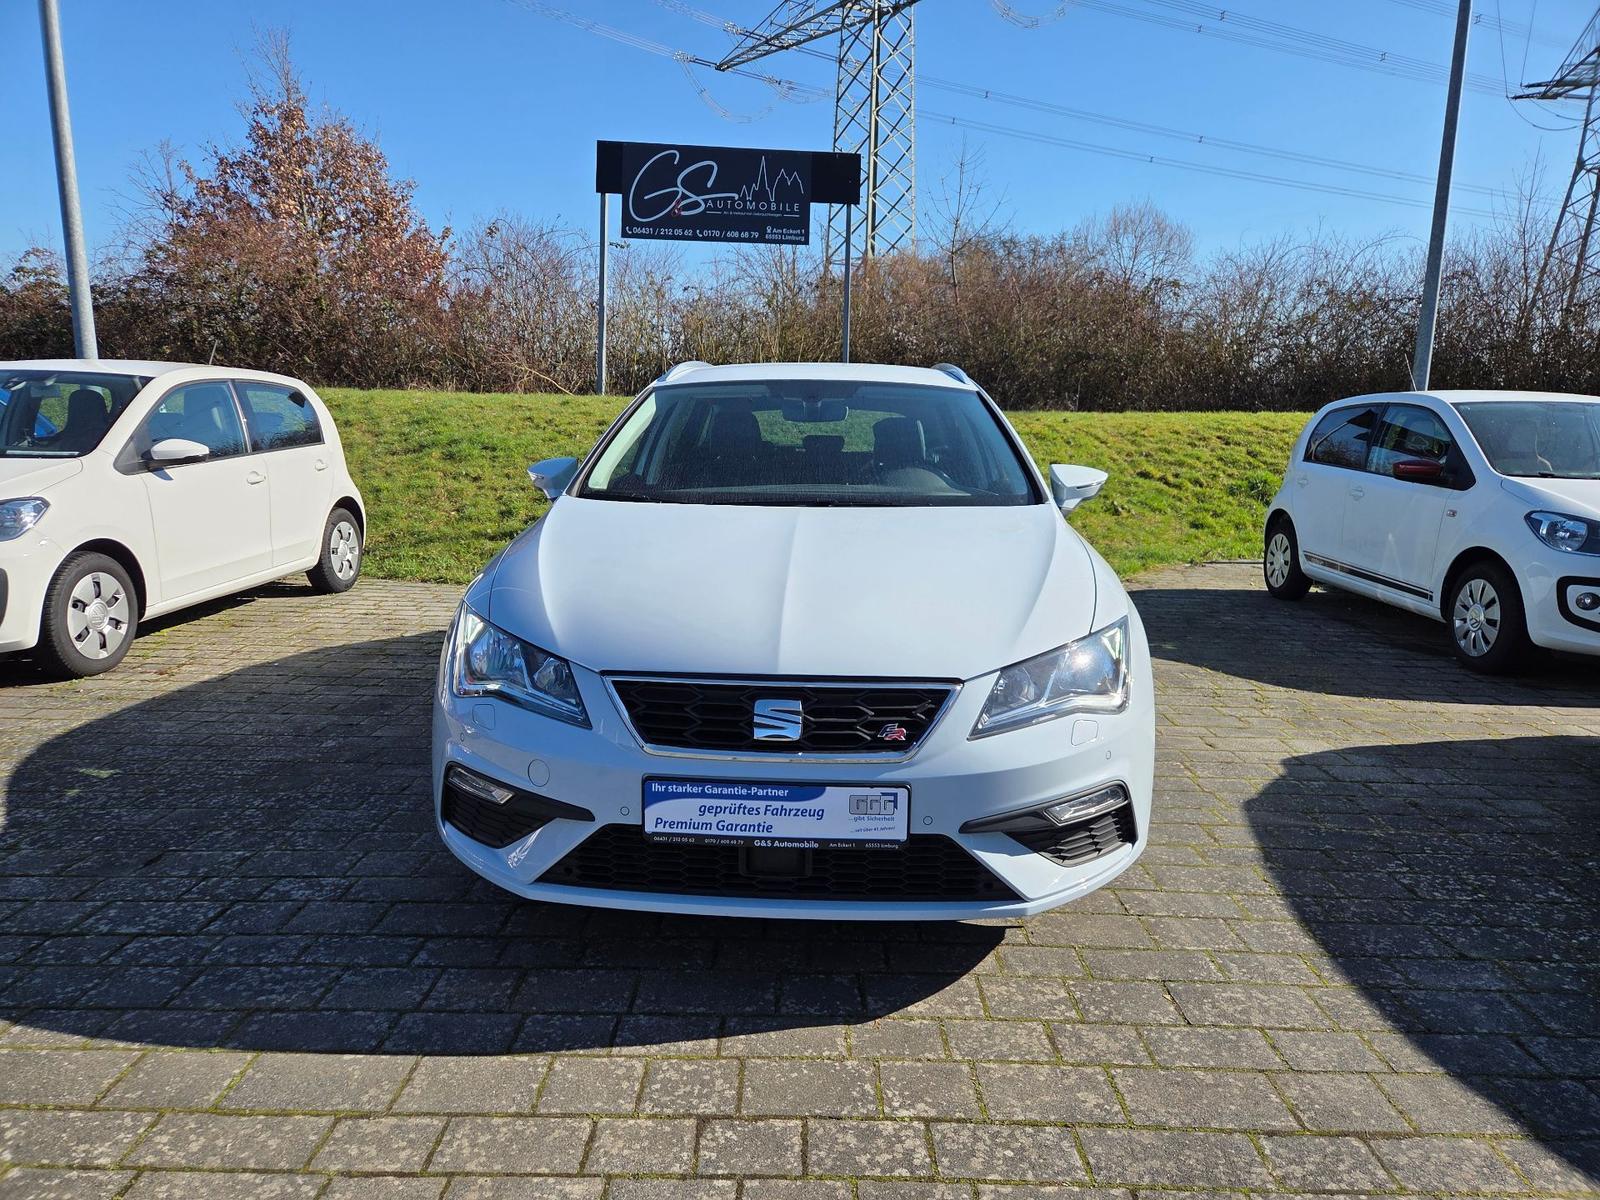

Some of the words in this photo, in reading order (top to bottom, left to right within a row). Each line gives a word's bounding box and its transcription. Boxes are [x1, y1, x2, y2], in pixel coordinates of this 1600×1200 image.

[706, 200, 800, 212] AUTOMOBILE
[652, 783, 668, 792] Ihr
[668, 784, 702, 793] starker
[704, 786, 788, 797] Garantie-Partner
[698, 803, 761, 817] geprüftes
[764, 804, 824, 820] Fahrzeug
[654, 817, 712, 830] Premium
[716, 820, 773, 833] Garantie
[773, 840, 819, 848] Automobile
